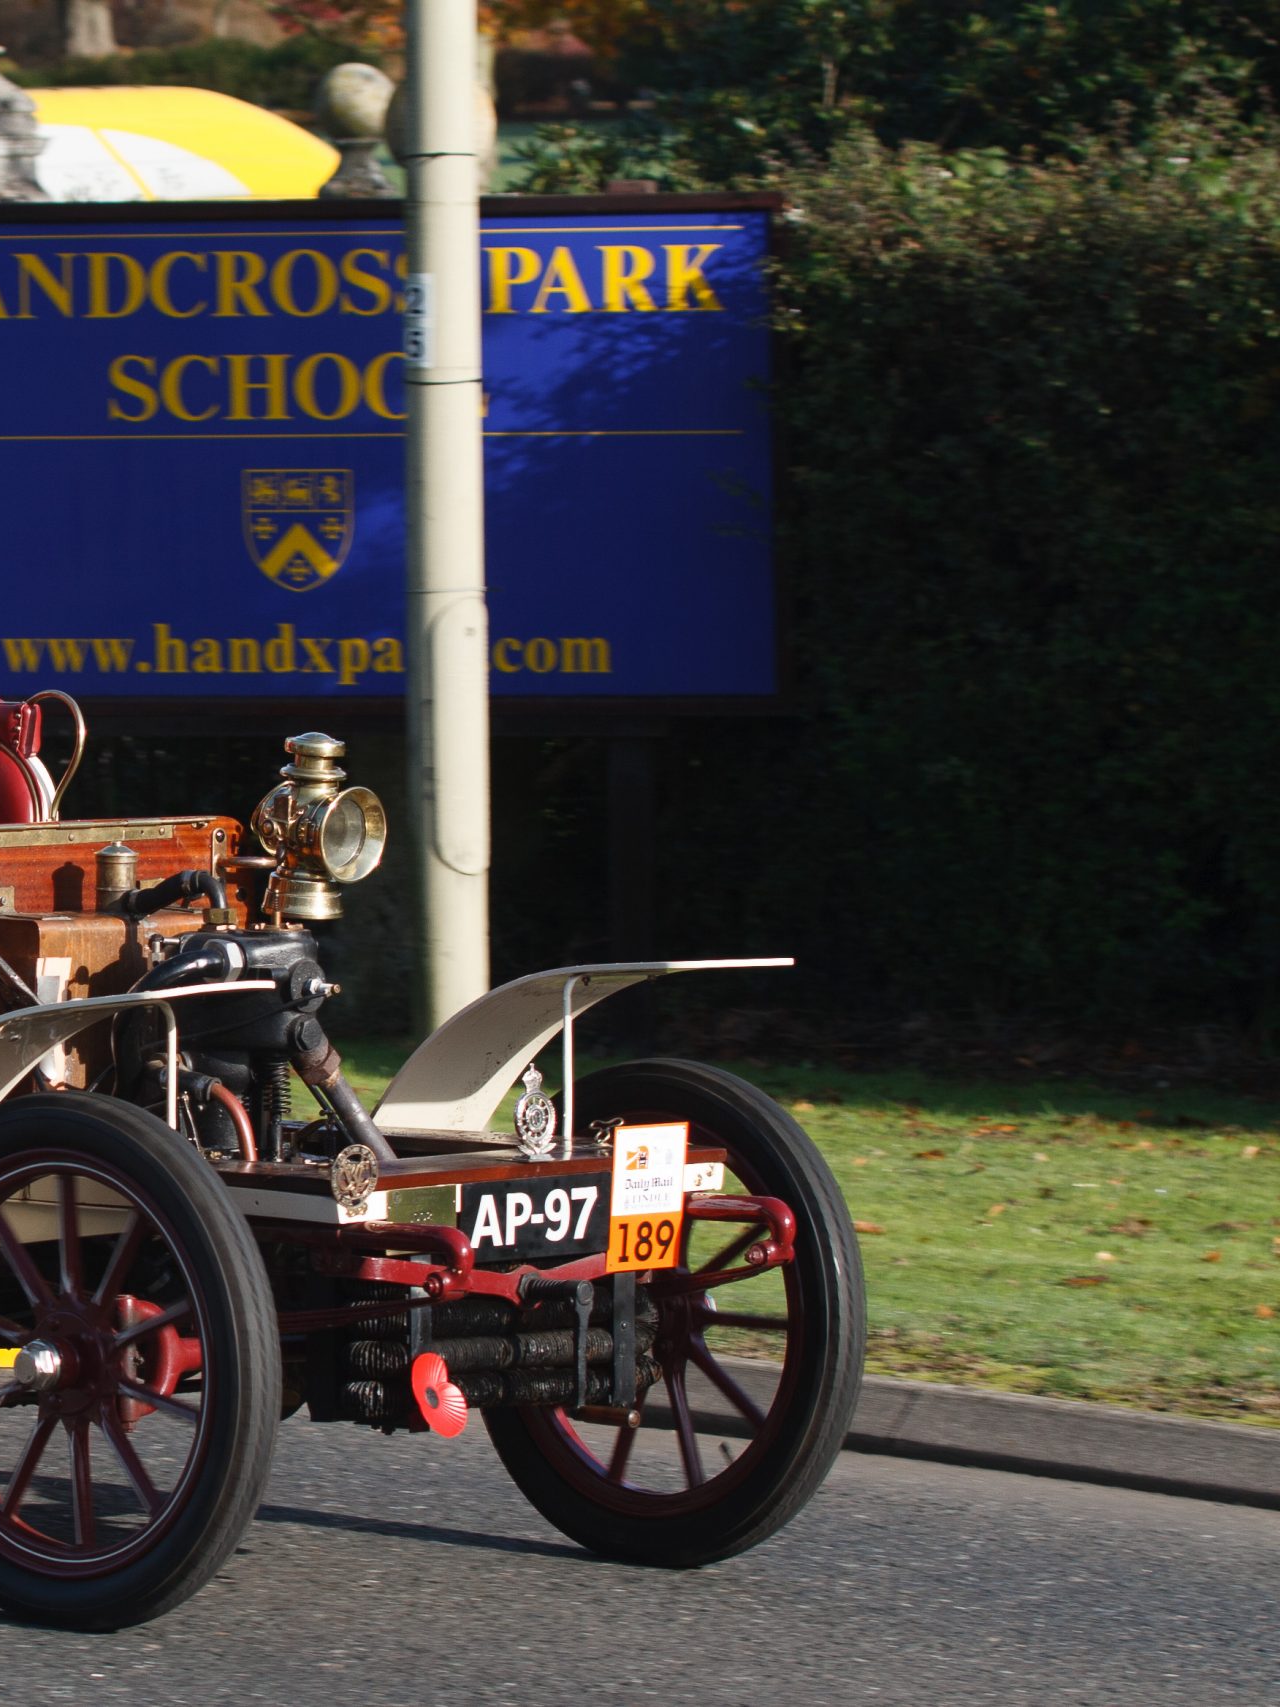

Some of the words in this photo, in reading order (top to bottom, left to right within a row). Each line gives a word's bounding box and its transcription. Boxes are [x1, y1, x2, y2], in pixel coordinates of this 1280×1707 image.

[482, 243, 726, 315] PARK
[107, 352, 490, 421] SCHOO
[470, 1185, 599, 1249] AP-97
[618, 1219, 675, 1263] 189
